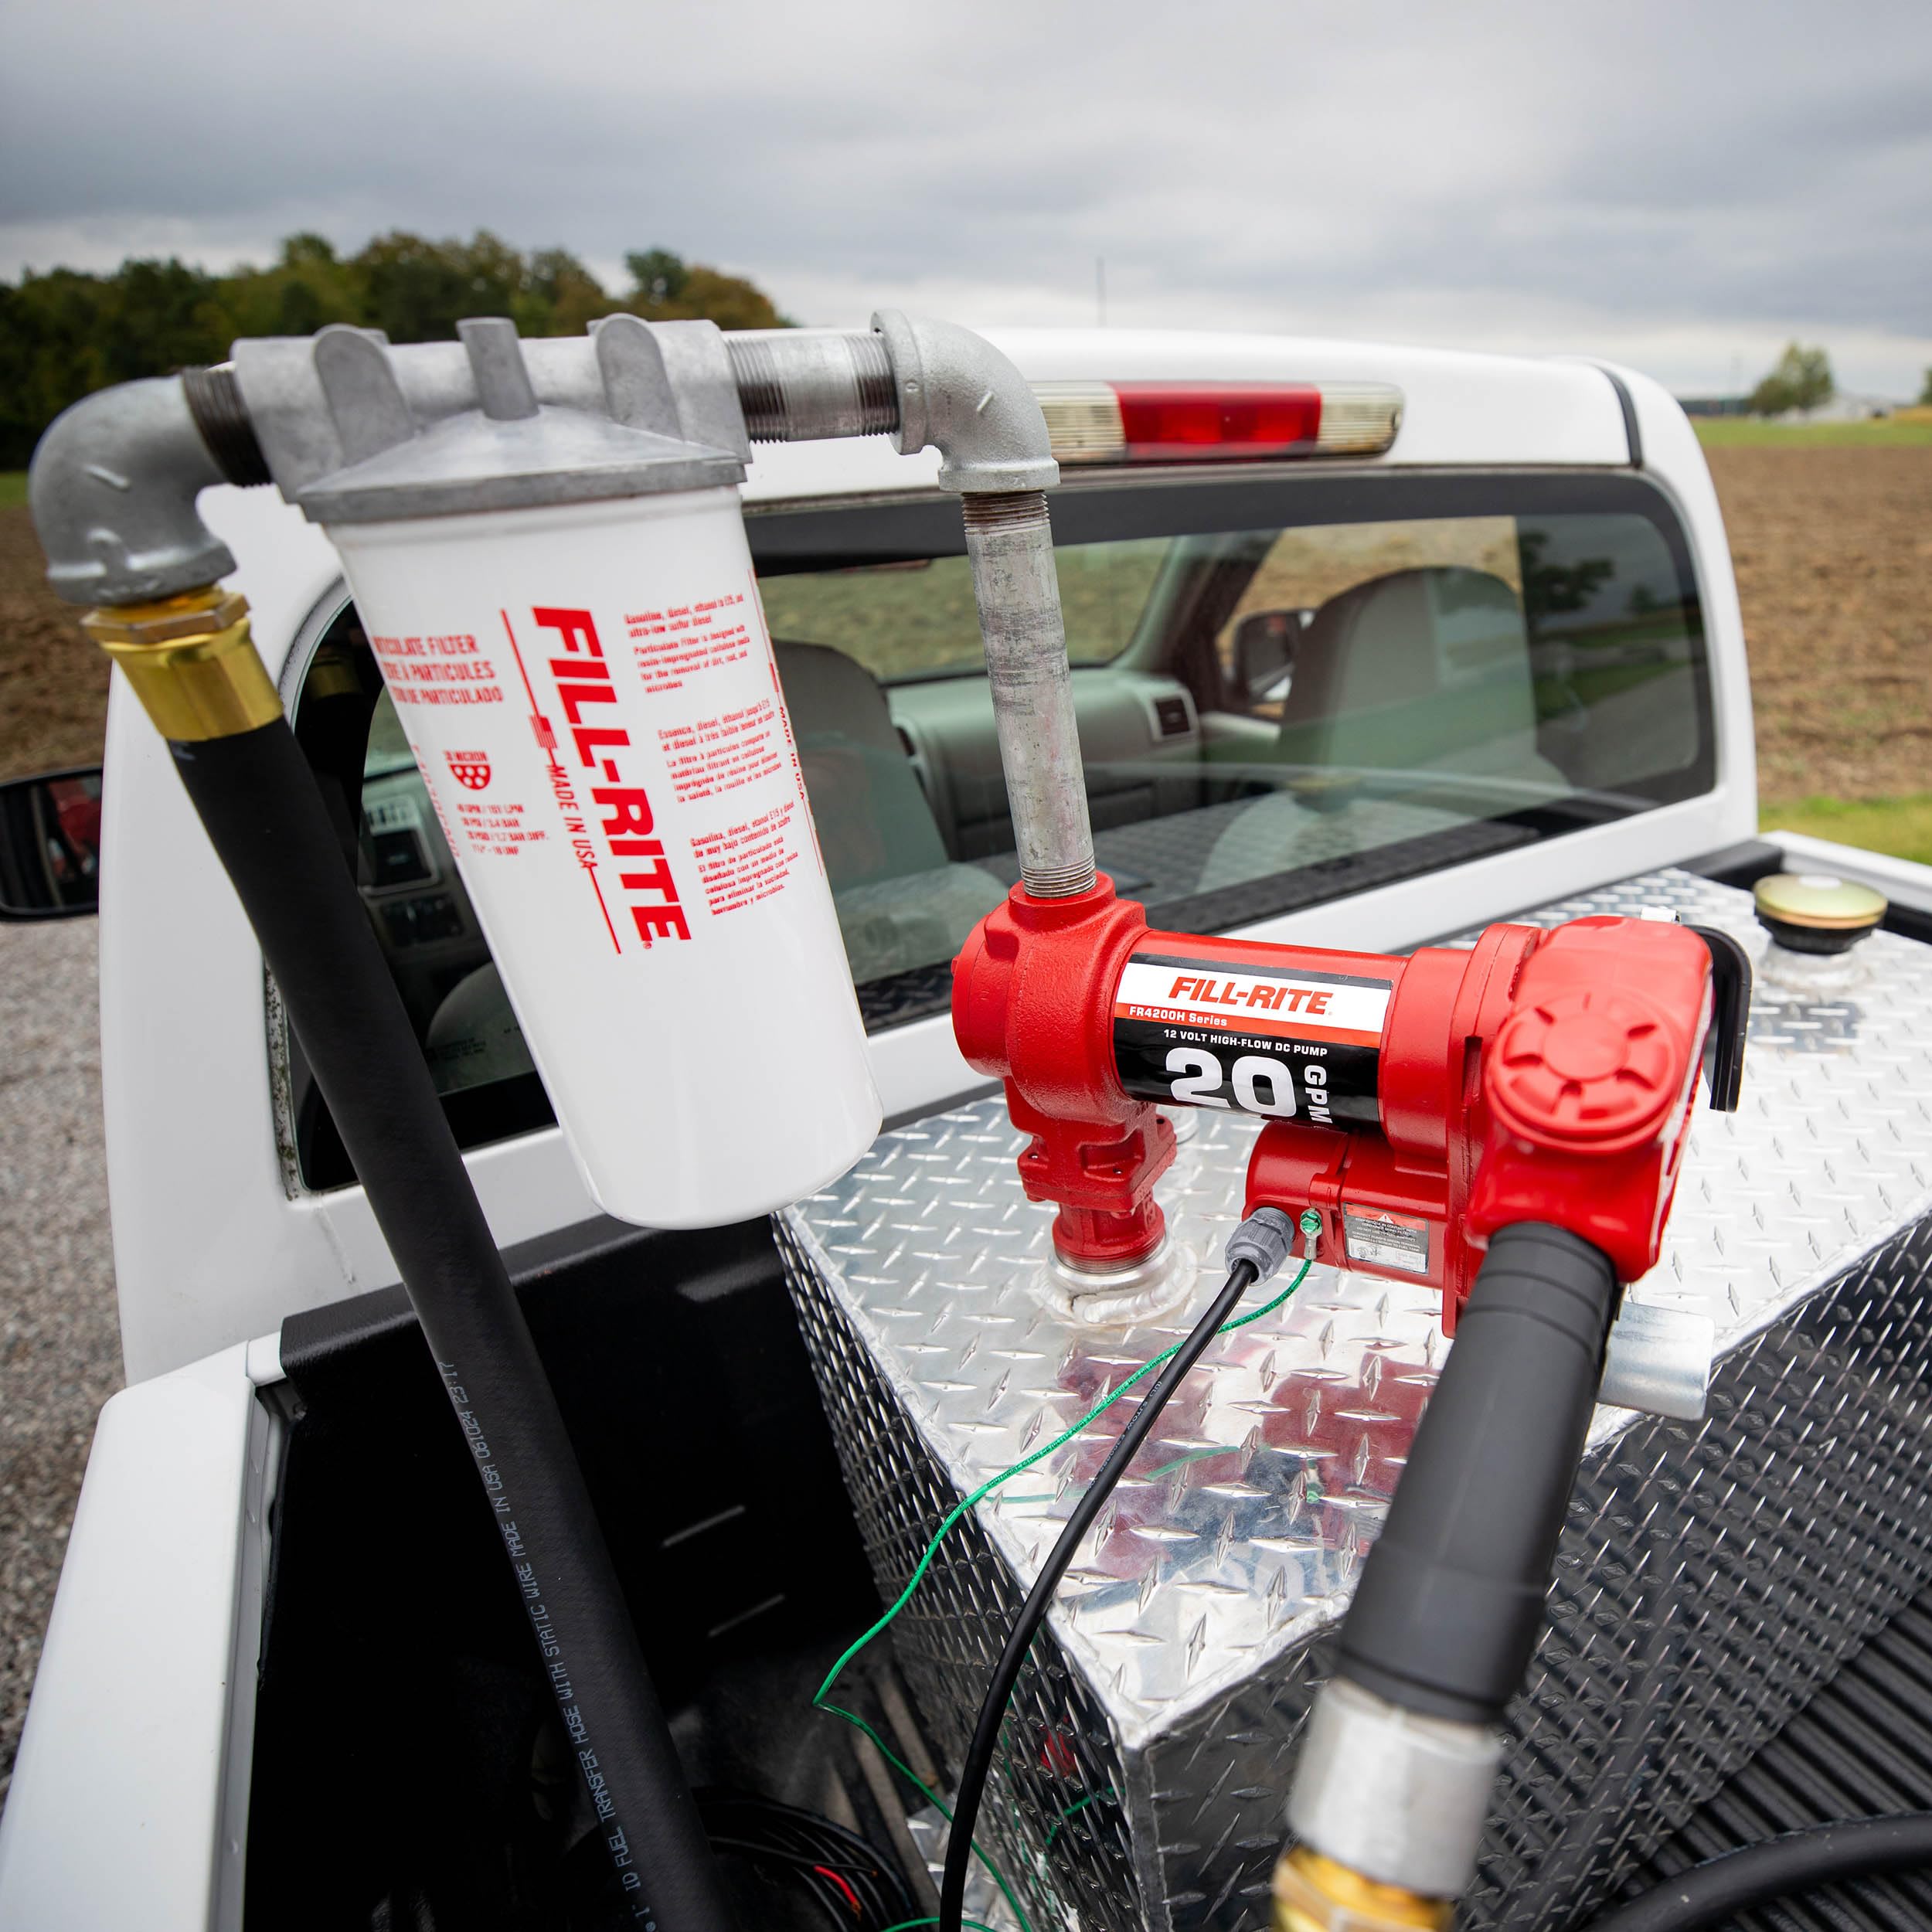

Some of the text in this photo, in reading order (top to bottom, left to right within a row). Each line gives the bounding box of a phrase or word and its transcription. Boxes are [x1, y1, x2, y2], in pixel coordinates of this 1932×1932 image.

[532, 606, 692, 940] FILL-RITE
[546, 764, 598, 869] MADE IN USA
[1168, 976, 1333, 1015] FILL-RITE
[1129, 1006, 1227, 1026] FR4200H Series
[1163, 1029, 1328, 1056] 12 VOLT HIGH-FLOW DC PUMP
[1165, 1047, 1296, 1117] 20
[1304, 1065, 1332, 1124] GPM
[460, 1410, 491, 1459] 061024
[482, 1464, 502, 1491] USA
[492, 1496, 511, 1513] IN
[502, 1521, 526, 1557] MADE
[515, 1562, 540, 1599] WIRE
[530, 1604, 560, 1657] STATIC
[549, 1662, 574, 1700] WITH
[563, 1705, 589, 1744] HOSE
[579, 1748, 616, 1822] TRANSFER
[608, 1826, 632, 1867] FUEL
[621, 1872, 641, 1892] ID
